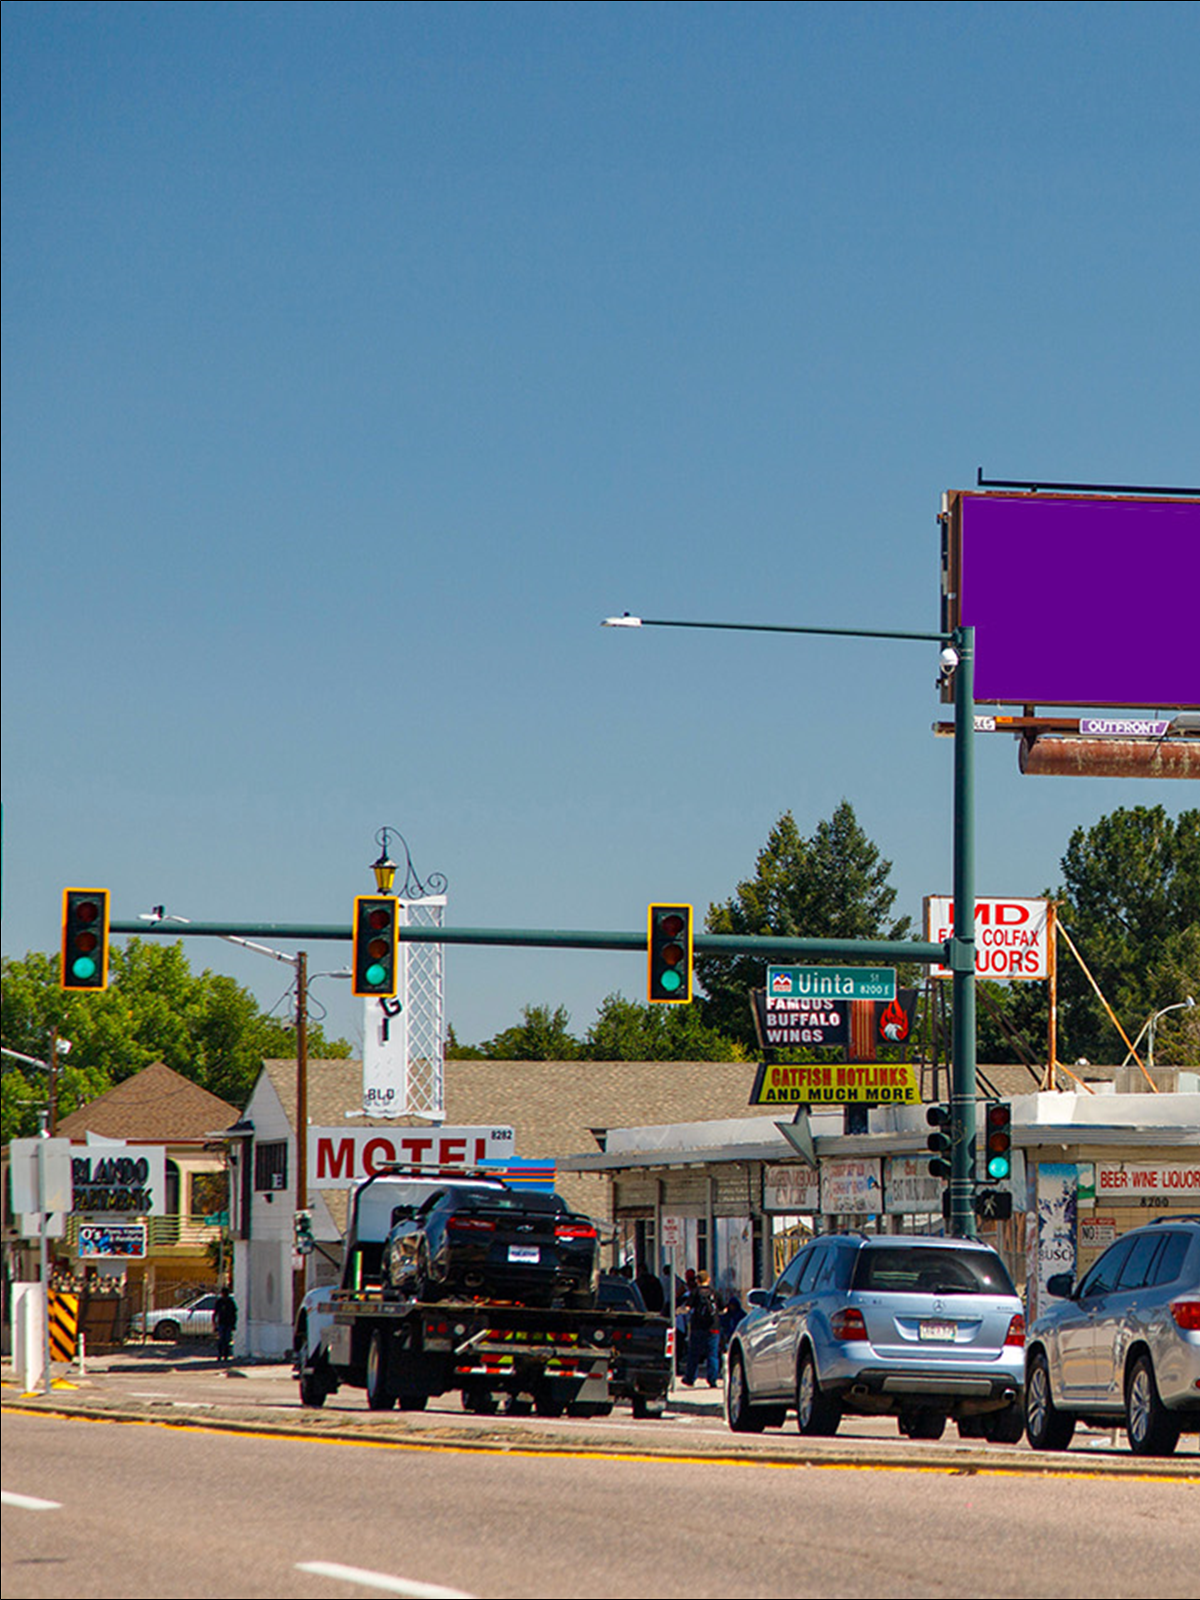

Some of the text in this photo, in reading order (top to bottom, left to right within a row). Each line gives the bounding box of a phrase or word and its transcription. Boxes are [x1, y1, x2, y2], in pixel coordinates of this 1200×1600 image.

[1088, 720, 1159, 735] OUTFRONT
[982, 928, 1040, 947] COLFAX
[799, 972, 855, 994] Uinta
[859, 985, 883, 995] 8200
[766, 998, 834, 1011] FAMOUS
[766, 1012, 841, 1027] BUFFALO
[766, 1029, 824, 1043] WINGS
[771, 1067, 908, 1088] CATFISH HOTLINKS
[766, 1088, 915, 1101] AND MUCH MORE
[490, 1130, 513, 1141] 8282
[72, 1157, 149, 1186] RLANDO
[1100, 1170, 1129, 1189] BEER
[1131, 1170, 1159, 1189] WINE
[1139, 1197, 1170, 1208] 8200
[1081, 1225, 1095, 1240] NO
